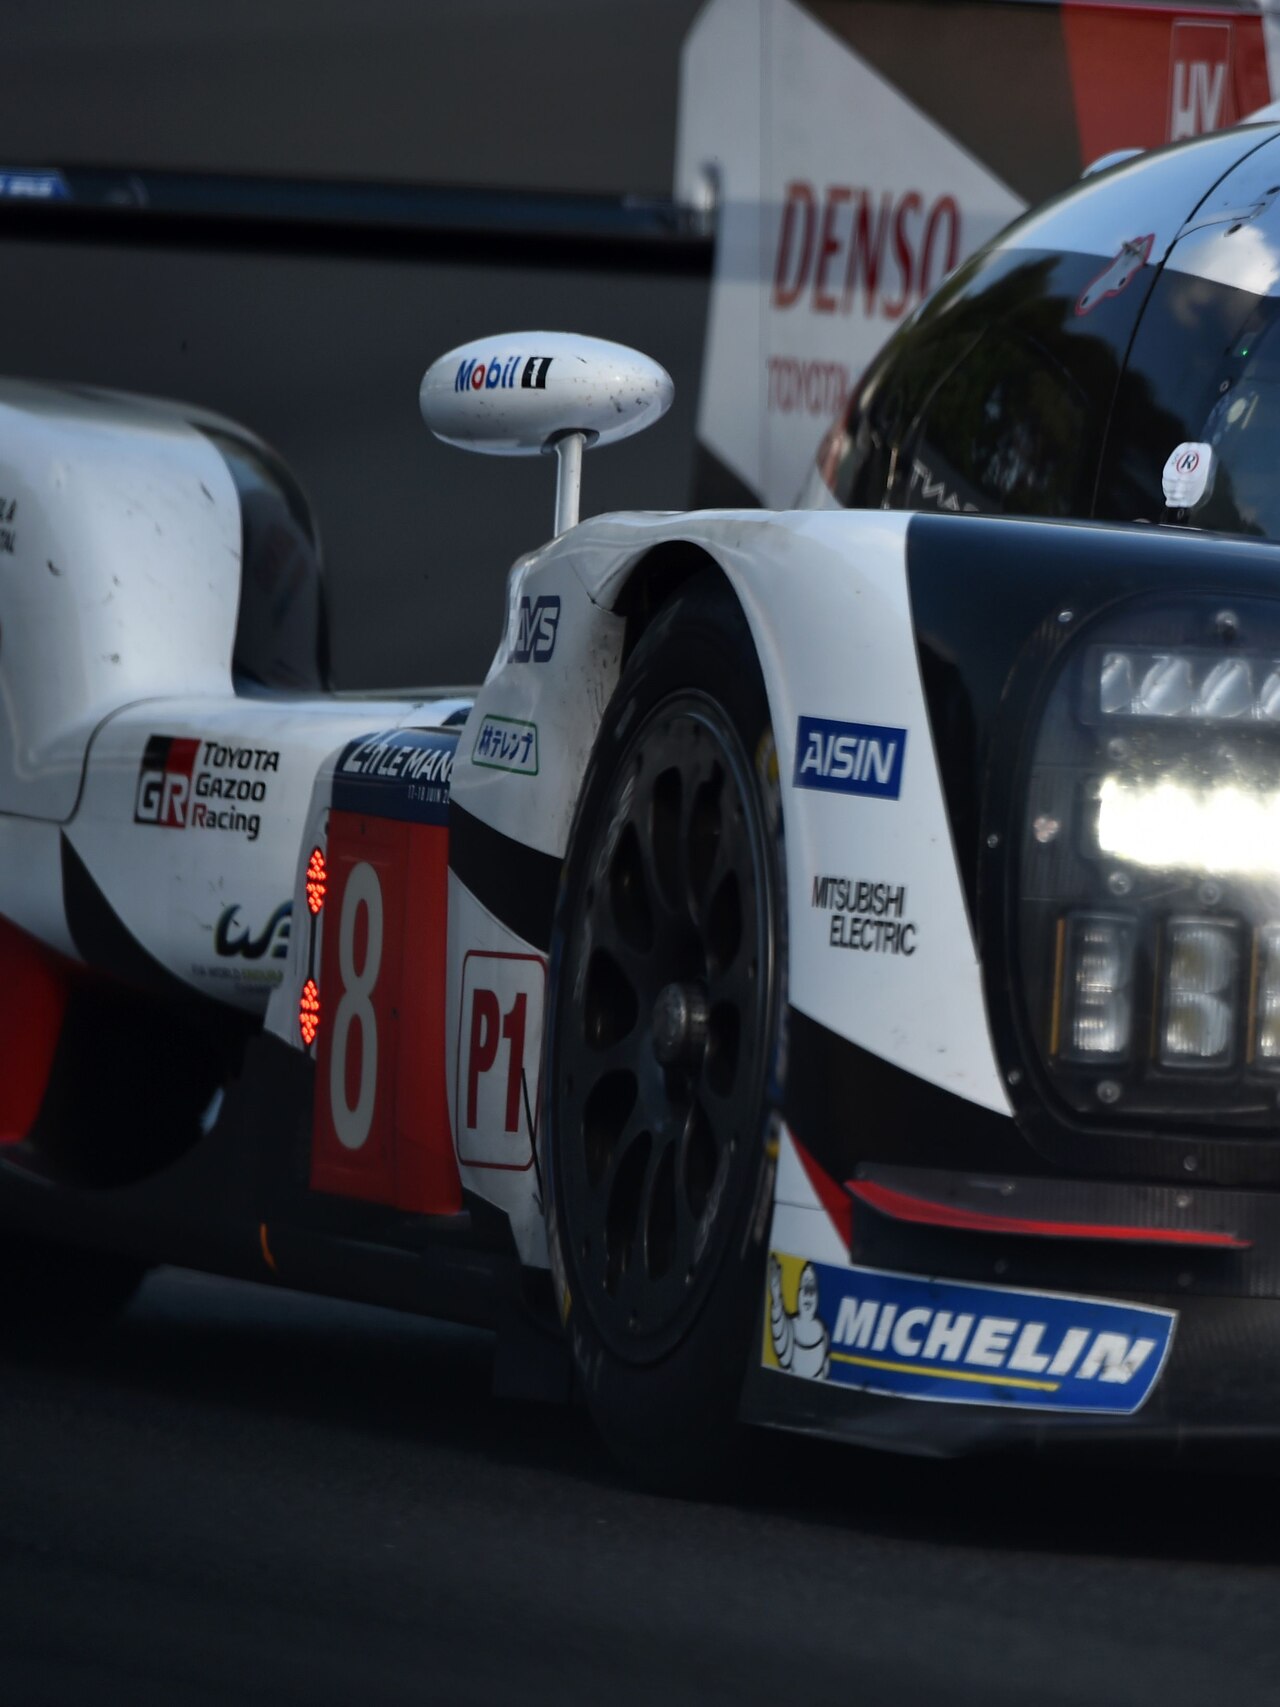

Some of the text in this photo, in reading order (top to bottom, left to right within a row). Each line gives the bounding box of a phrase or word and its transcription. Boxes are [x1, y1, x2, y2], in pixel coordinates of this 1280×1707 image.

[773, 180, 961, 318] DENSO
[454, 356, 521, 392] Mobil
[203, 741, 279, 772] TOYOTA
[801, 732, 896, 784] AISIN
[137, 770, 190, 825] GR
[195, 772, 266, 801] GAZOO
[191, 802, 261, 841] Racing
[812, 875, 906, 918] MITSUBISHI
[829, 914, 917, 957] ELECTRIC
[330, 861, 383, 1149] 8
[467, 988, 528, 1133] P1
[832, 1297, 1157, 1385] MICHELIN
